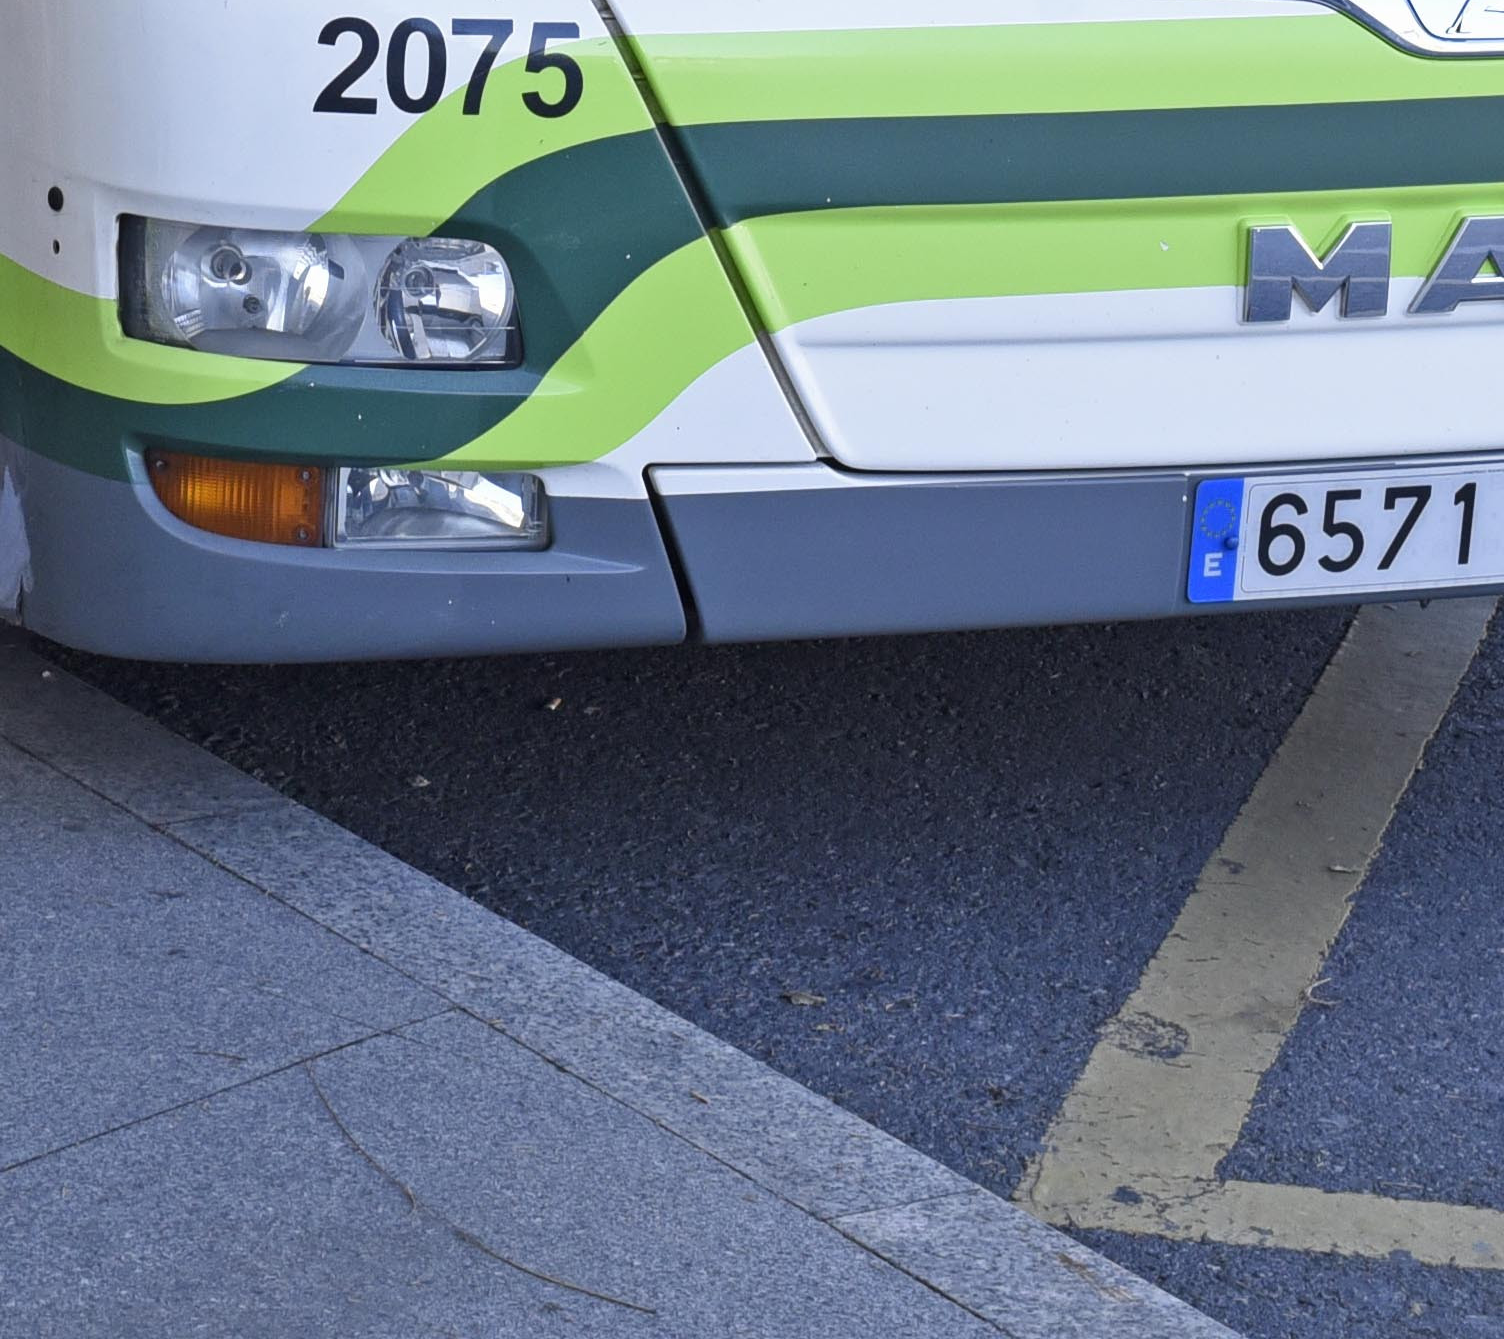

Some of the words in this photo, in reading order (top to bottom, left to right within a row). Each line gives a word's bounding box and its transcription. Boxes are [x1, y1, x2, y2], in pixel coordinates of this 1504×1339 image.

[312, 16, 584, 120] 2075
[1202, 552, 1223, 579] E
[1256, 480, 1477, 578] 6571
